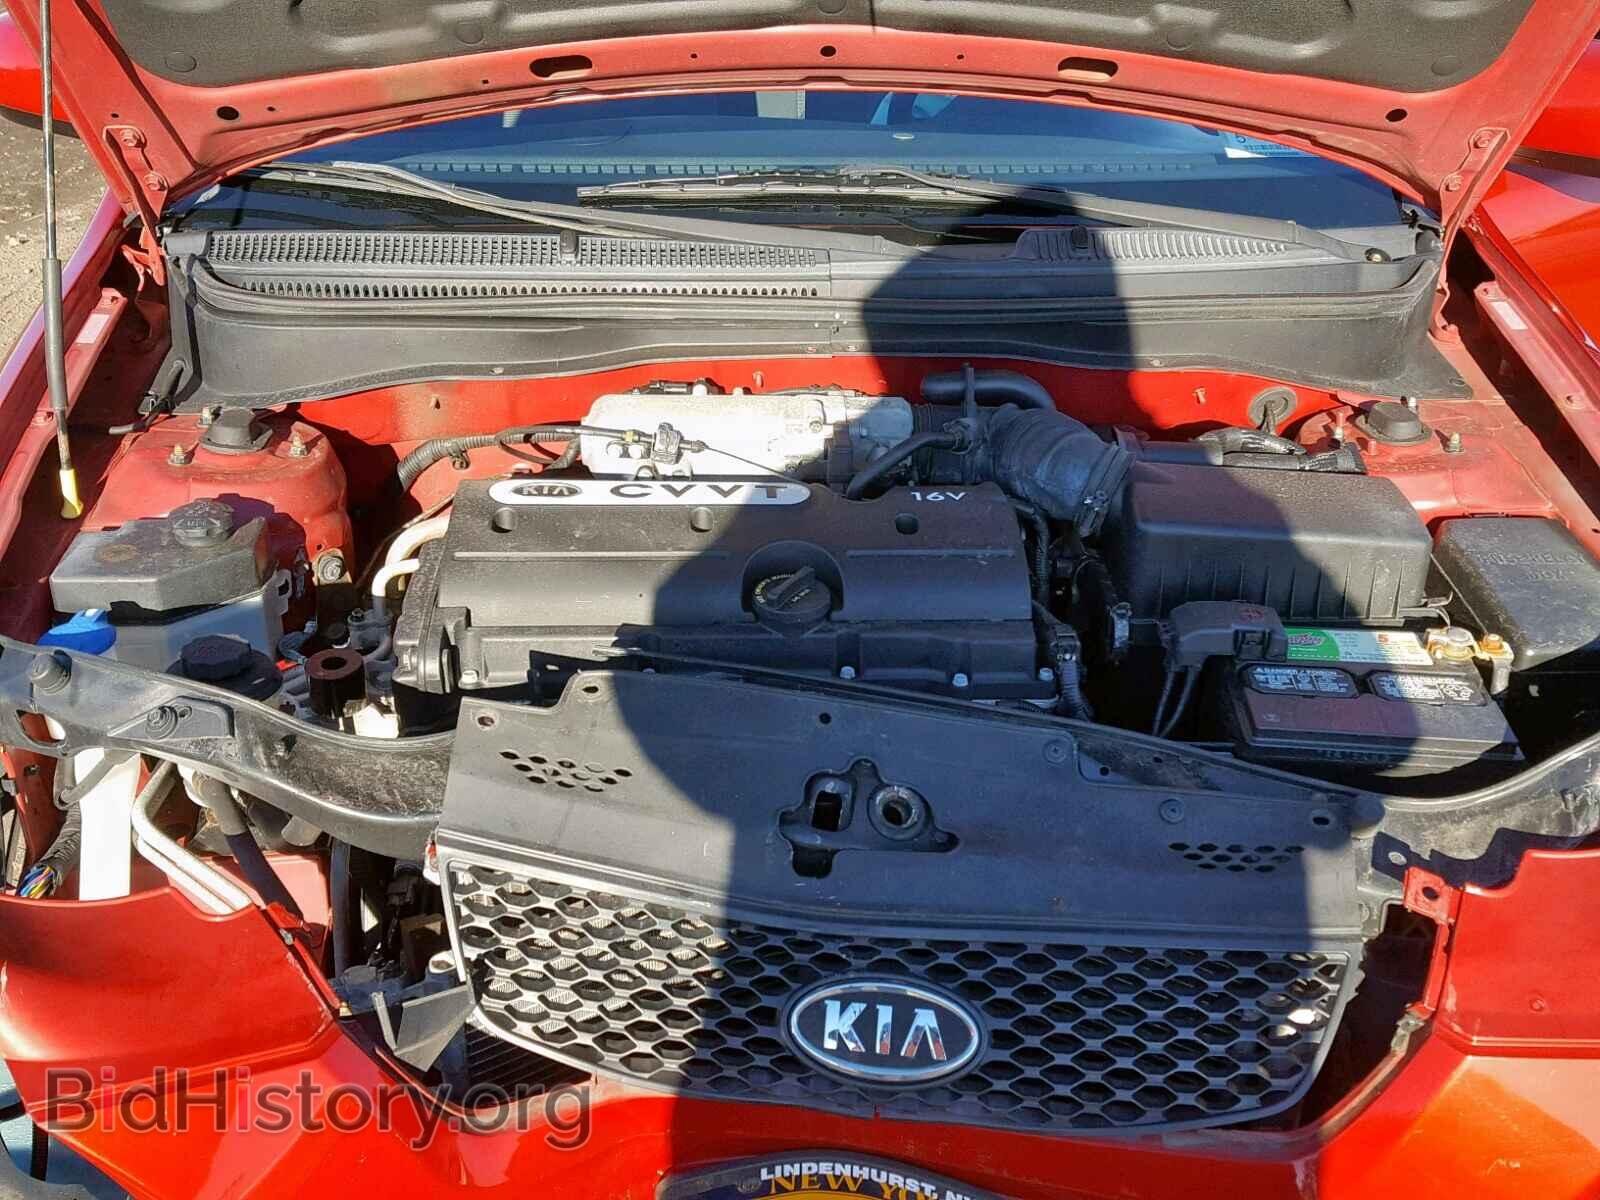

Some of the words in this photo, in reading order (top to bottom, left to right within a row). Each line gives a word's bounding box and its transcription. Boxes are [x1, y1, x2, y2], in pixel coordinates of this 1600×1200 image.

[522, 484, 569, 496] KIA
[610, 484, 787, 499] CVVT
[911, 491, 966, 501] 16V
[823, 1000, 947, 1061] KIA
[761, 1162, 938, 1200] LINDENHURST,
